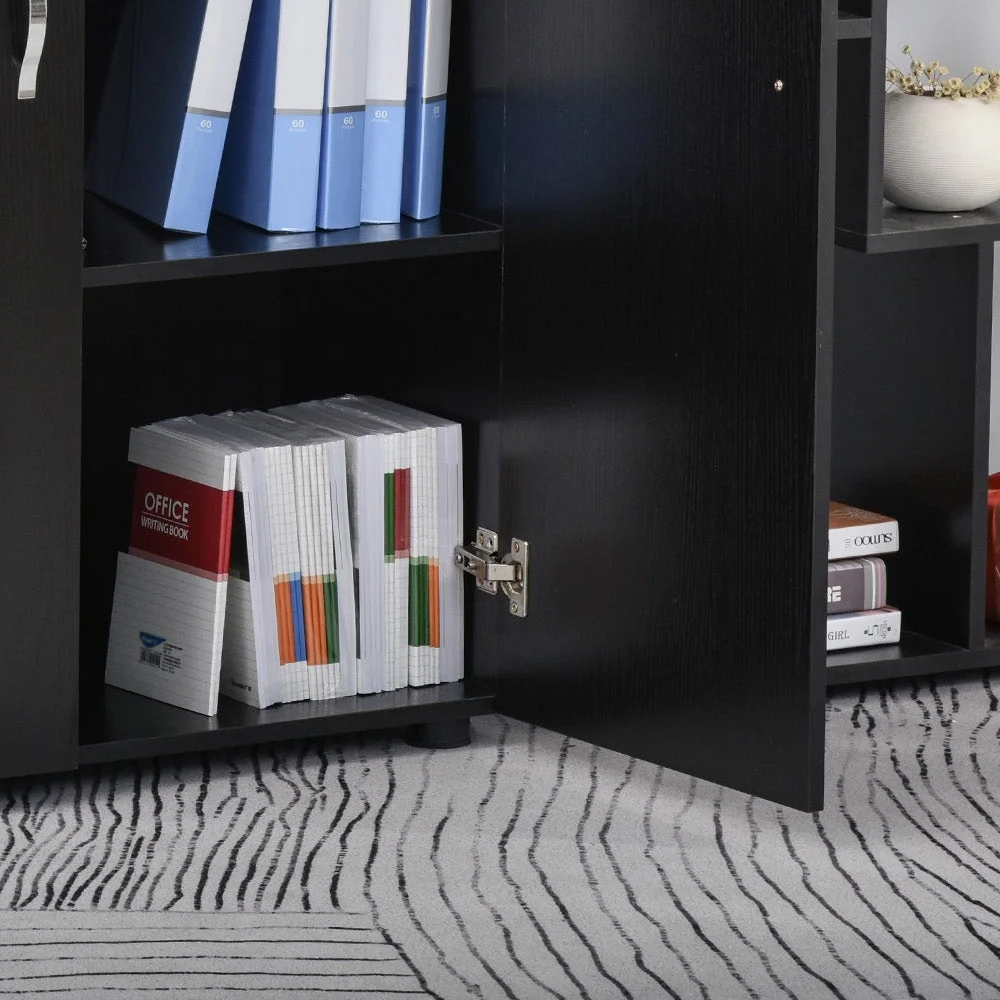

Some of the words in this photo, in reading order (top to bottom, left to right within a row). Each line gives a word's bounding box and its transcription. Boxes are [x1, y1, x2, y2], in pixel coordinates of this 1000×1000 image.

[375, 109, 388, 119] 60
[200, 119, 212, 130] 60
[292, 119, 305, 129] 60
[343, 116, 354, 126] 60
[144, 491, 190, 524] OFFICE
[141, 515, 169, 535] WRITING
[169, 522, 189, 541] BOOK
[828, 630, 850, 641] GIRL
